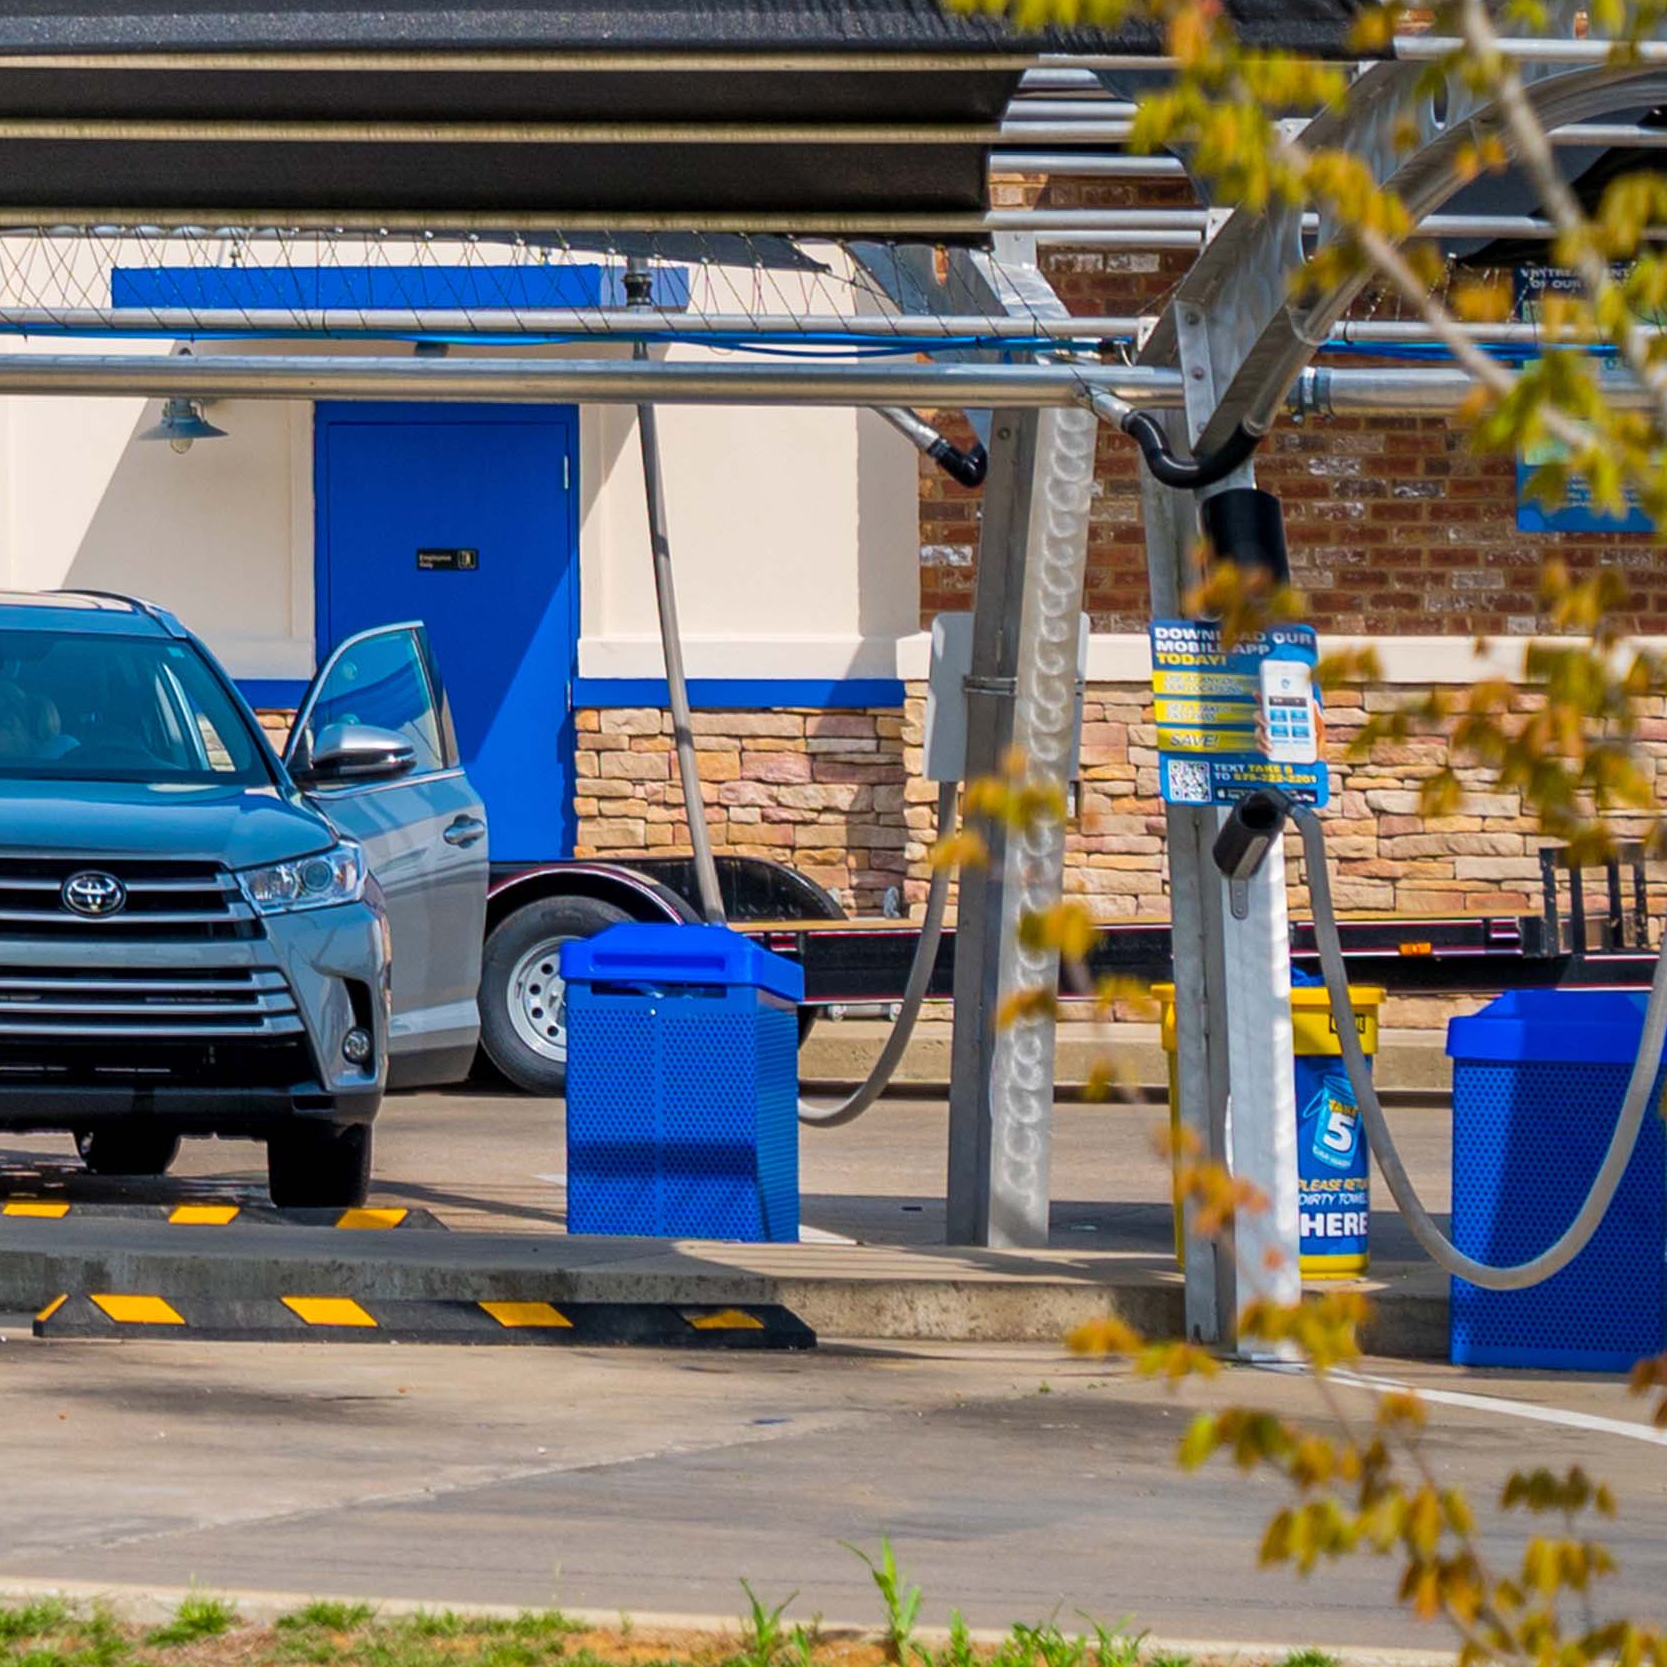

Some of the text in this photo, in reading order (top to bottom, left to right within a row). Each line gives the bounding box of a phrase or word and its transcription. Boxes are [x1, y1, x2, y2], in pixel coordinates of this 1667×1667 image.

[1154, 627, 1314, 644] DOWNLAD OUR
[1232, 643, 1271, 655] APP
[1156, 653, 1228, 665] TODAY!
[1171, 733, 1221, 747] SAVE!
[1214, 763, 1245, 772] TEXT
[1248, 763, 1282, 773] TAKE
[1214, 772, 1231, 781] TO
[1323, 1112, 1356, 1152] 5
[1298, 1192, 1336, 1206] DIRTY
[1301, 1212, 1368, 1237] HERE
